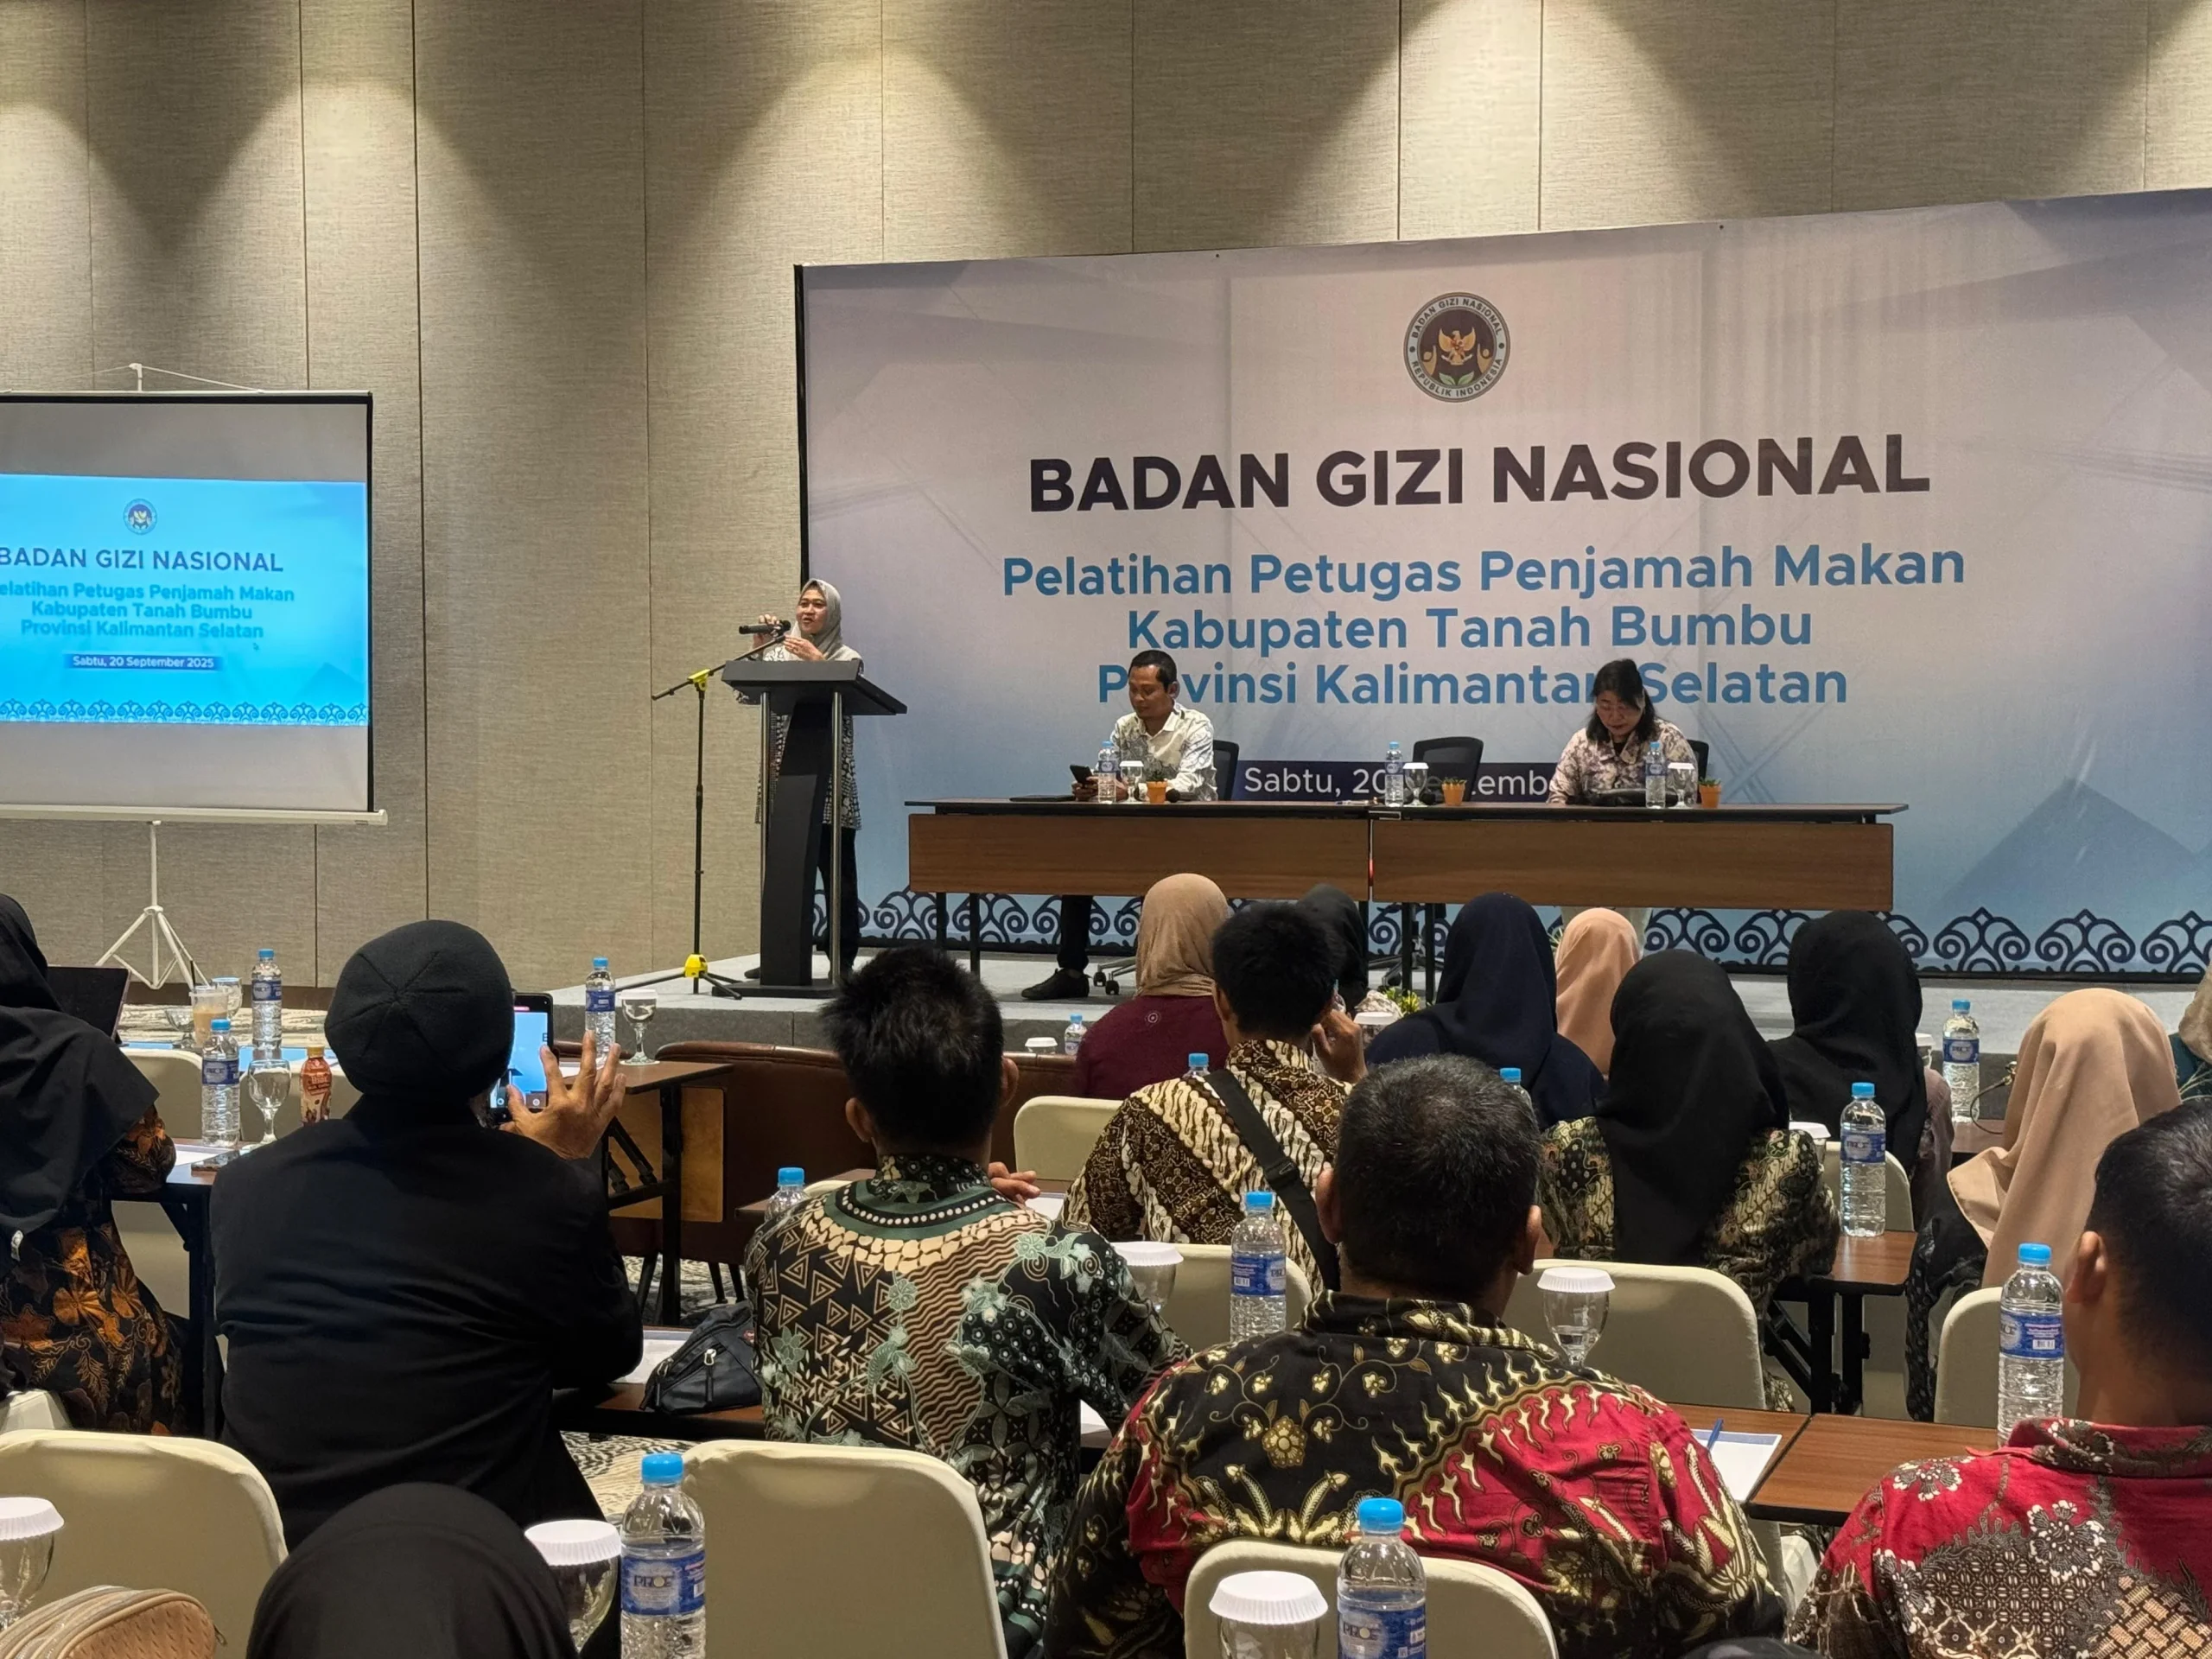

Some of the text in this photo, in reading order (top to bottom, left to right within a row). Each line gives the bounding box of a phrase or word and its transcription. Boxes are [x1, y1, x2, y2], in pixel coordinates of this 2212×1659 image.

[1411, 297, 1503, 339] BADAN GIZI NASIONAL
[1411, 359, 1503, 397] REPUBLIK INDONESIA
[1030, 433, 1930, 512] BADAN GIZI NASIONAL
[0, 546, 284, 573] BADAN GIZI NASIONAL
[1003, 542, 1965, 601] Pelatihan Petugas Penjamah Makan
[0, 580, 295, 602] elatihan Petugas Penjamah Makan
[31, 601, 253, 620] Kabupaten Tanah Bumbu
[20, 619, 264, 639] Provinsi Kalimantan Selatan
[1128, 603, 1812, 658] Kabupaten Tanah Bumbu
[73, 655, 214, 669] Sabtu, 20 September 2025
[1098, 661, 1297, 704] Pvinsi
[1641, 660, 1847, 704] Selatan
[1244, 766, 1341, 798] Sabtu,
